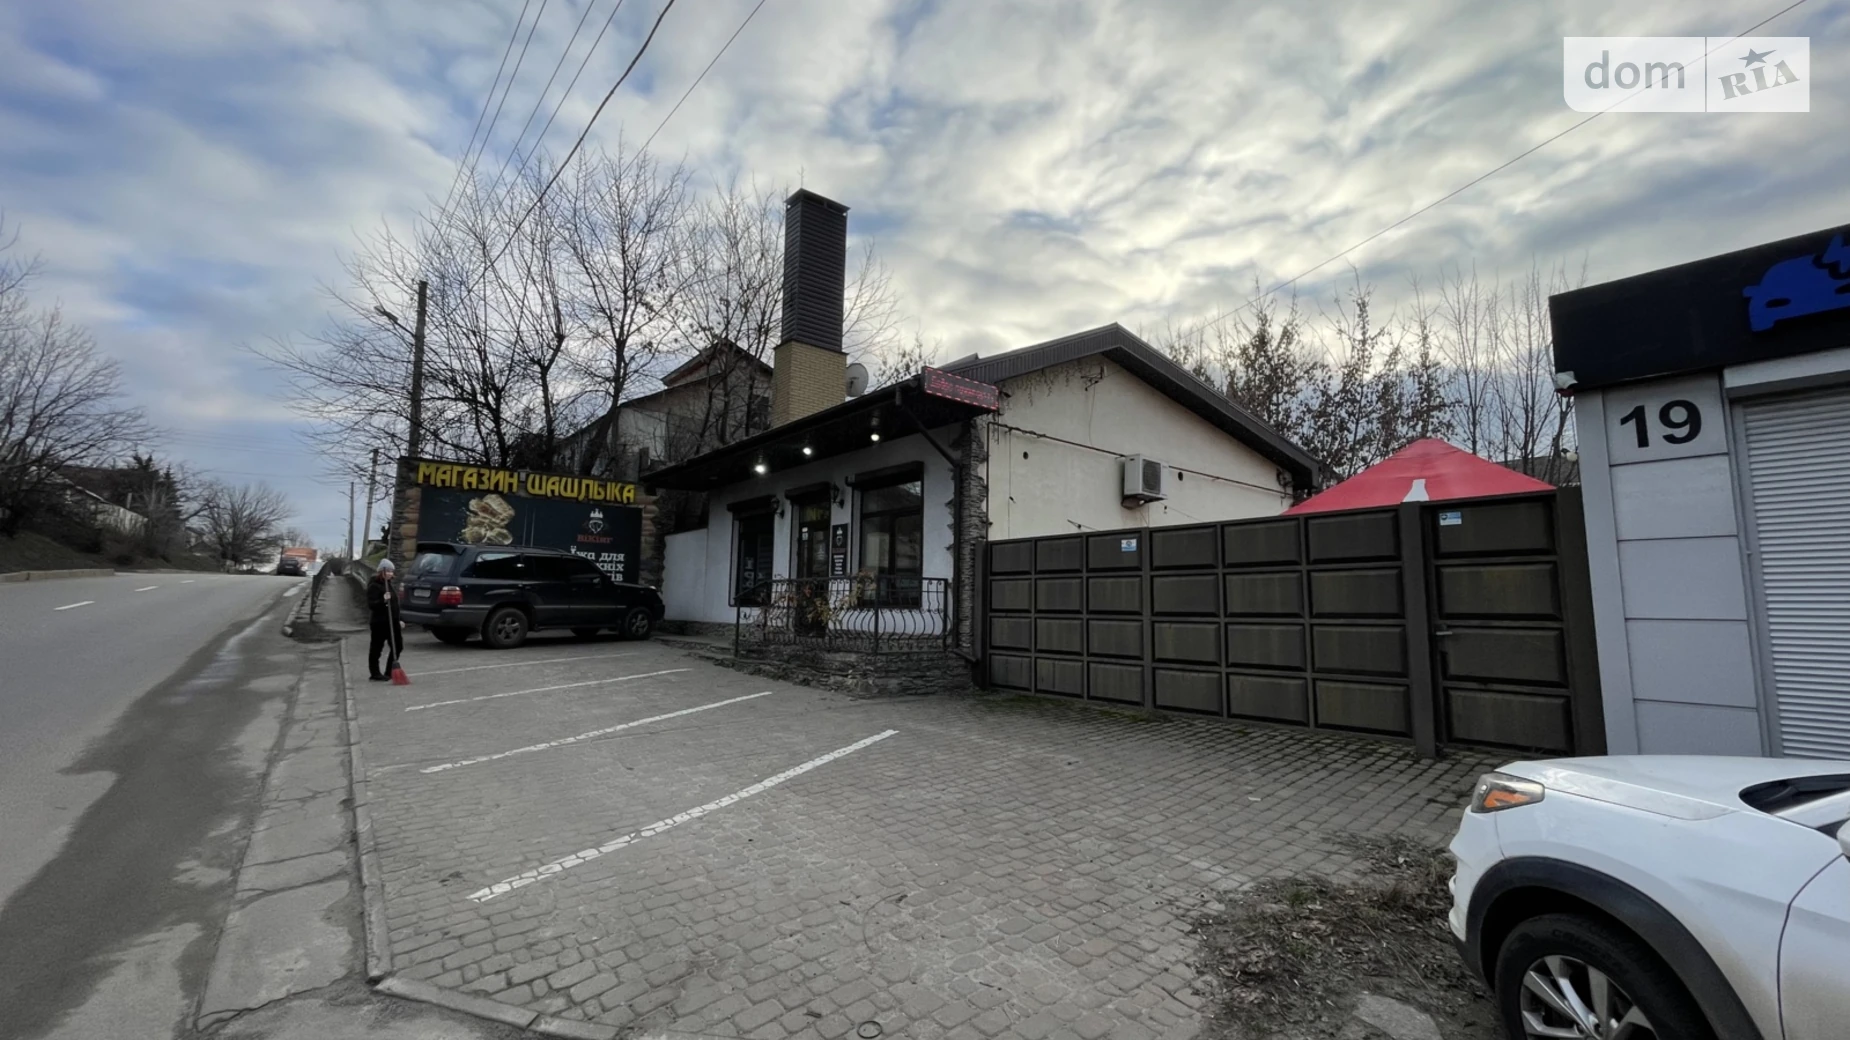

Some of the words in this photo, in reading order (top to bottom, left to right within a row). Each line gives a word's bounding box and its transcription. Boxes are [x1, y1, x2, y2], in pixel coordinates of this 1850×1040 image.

[1620, 400, 1702, 448] 19
[417, 461, 518, 494] МАГАЗИН
[527, 473, 636, 504] ШАШЛЫКА
[599, 552, 625, 562] для
